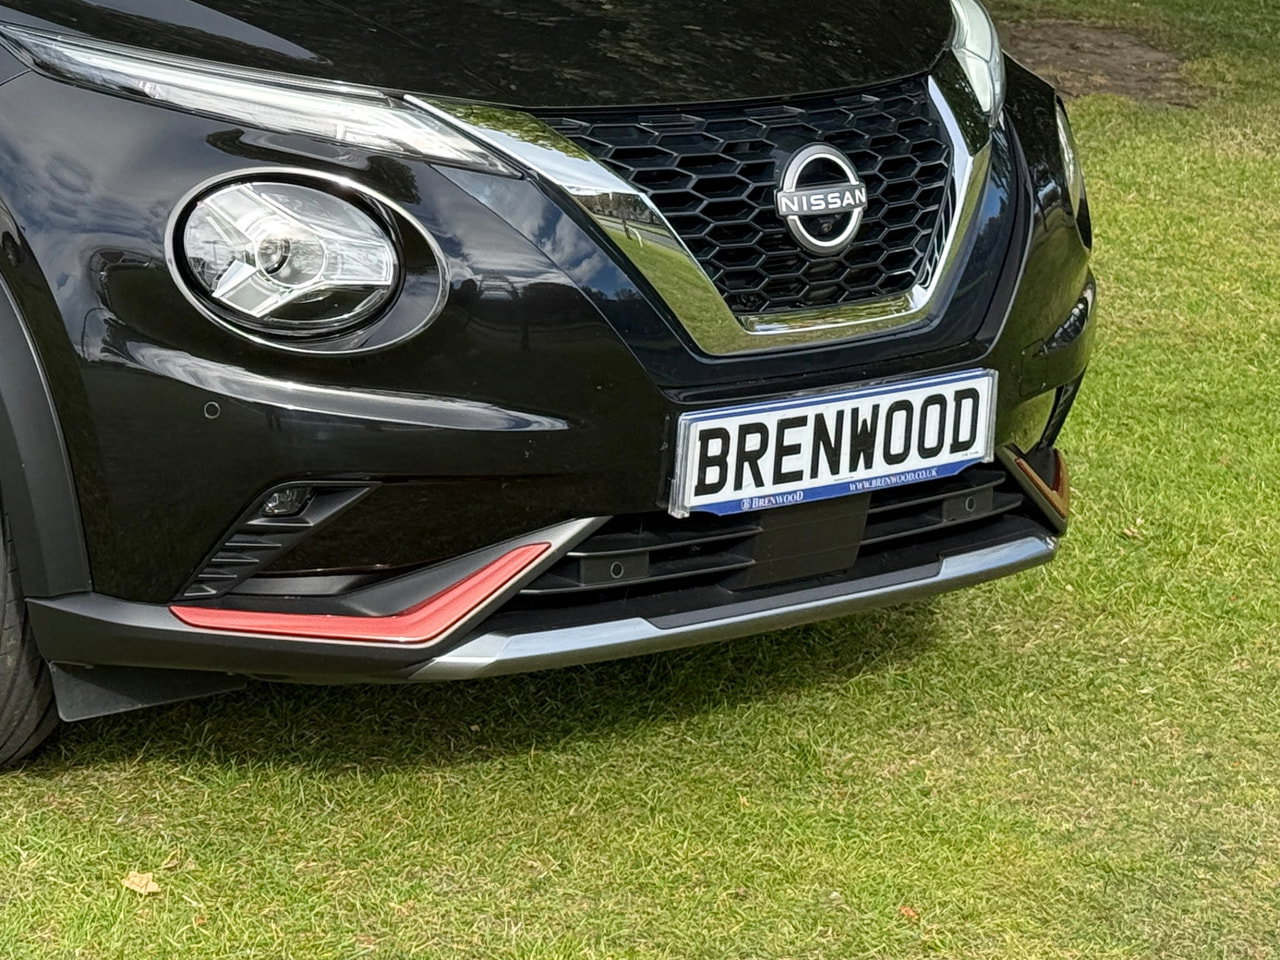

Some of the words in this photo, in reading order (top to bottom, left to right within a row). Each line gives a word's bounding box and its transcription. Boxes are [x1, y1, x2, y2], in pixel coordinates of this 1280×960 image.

[781, 187, 866, 212] NISSAN
[694, 388, 980, 497] BRENWOOD
[752, 490, 804, 509] BRENWOOD
